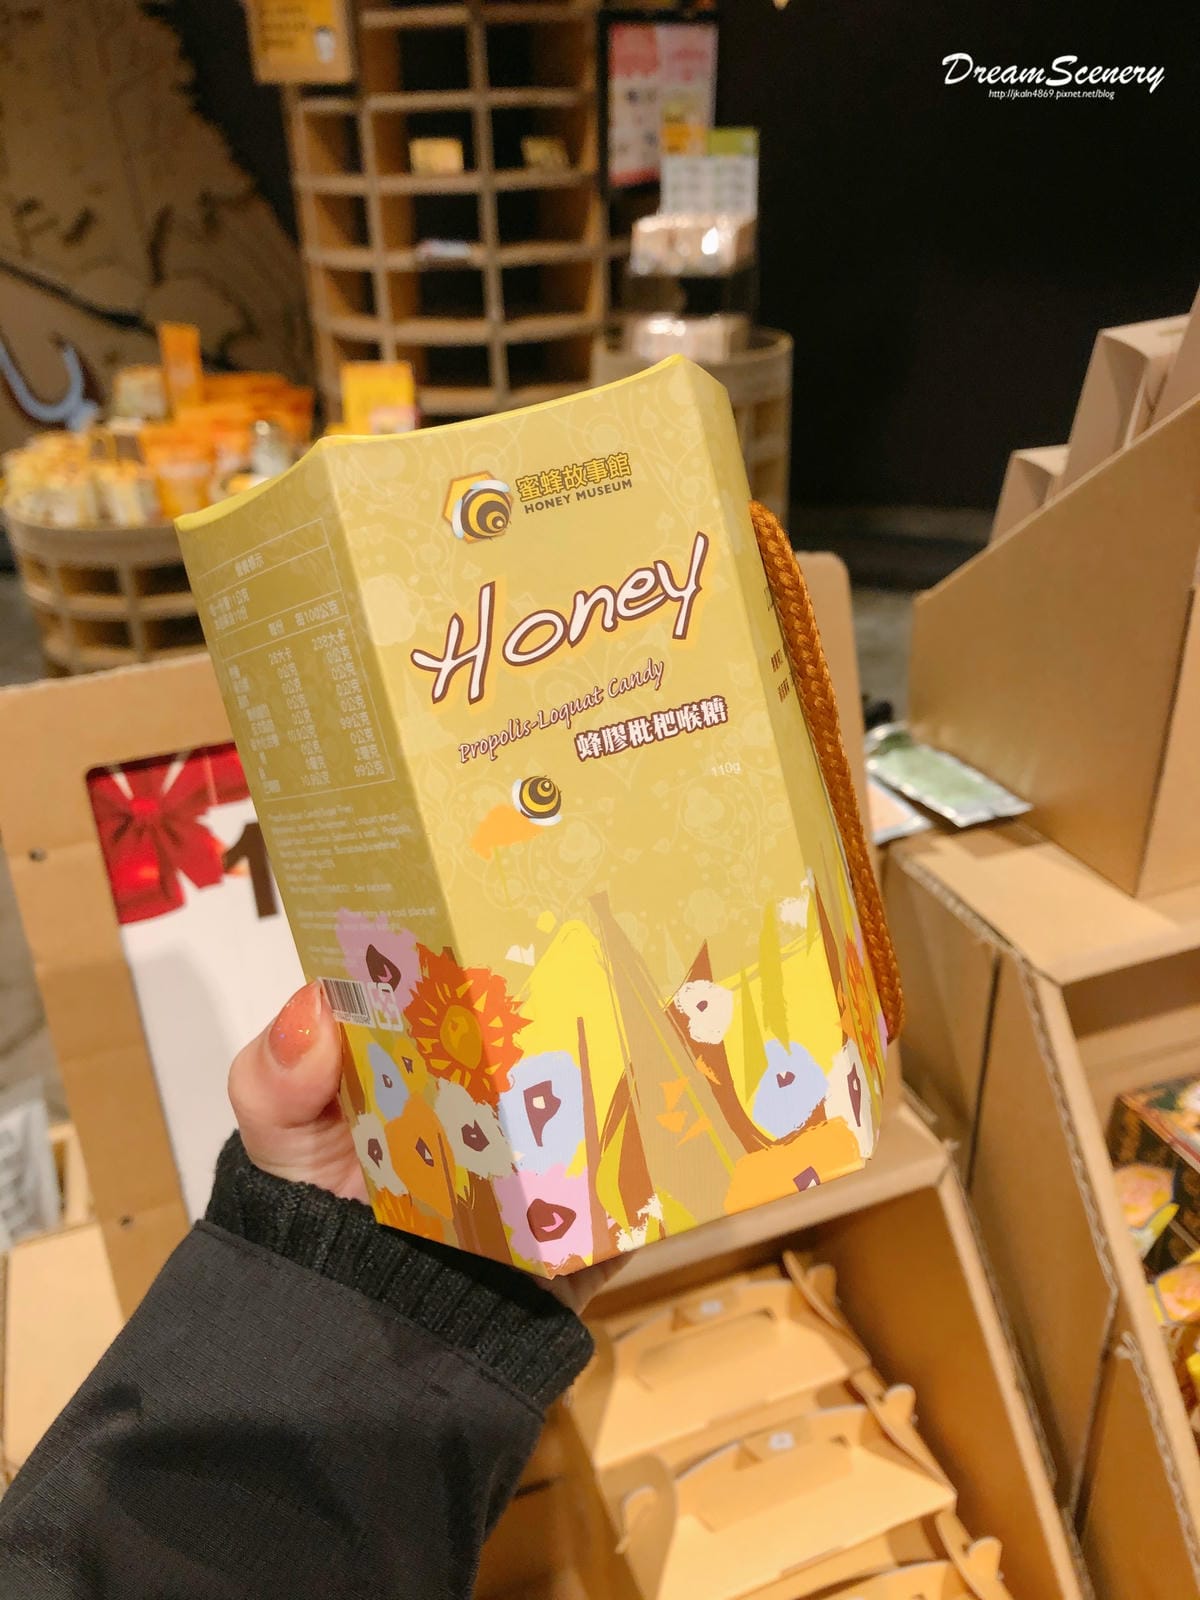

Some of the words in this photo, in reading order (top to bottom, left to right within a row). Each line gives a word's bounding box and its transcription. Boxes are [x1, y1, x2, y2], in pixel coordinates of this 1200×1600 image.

[516, 452, 632, 502] 蜜蜂故事館
[524, 493, 571, 515] HONEY
[576, 478, 633, 501] MUSEUM
[294, 599, 338, 627] 每100公克
[410, 530, 710, 705] Honey
[459, 685, 604, 764] Propolis-Loquat
[608, 657, 665, 698] Candy
[574, 694, 729, 762] 蜂膠枇杷喉糖
[711, 761, 742, 777] 110g
